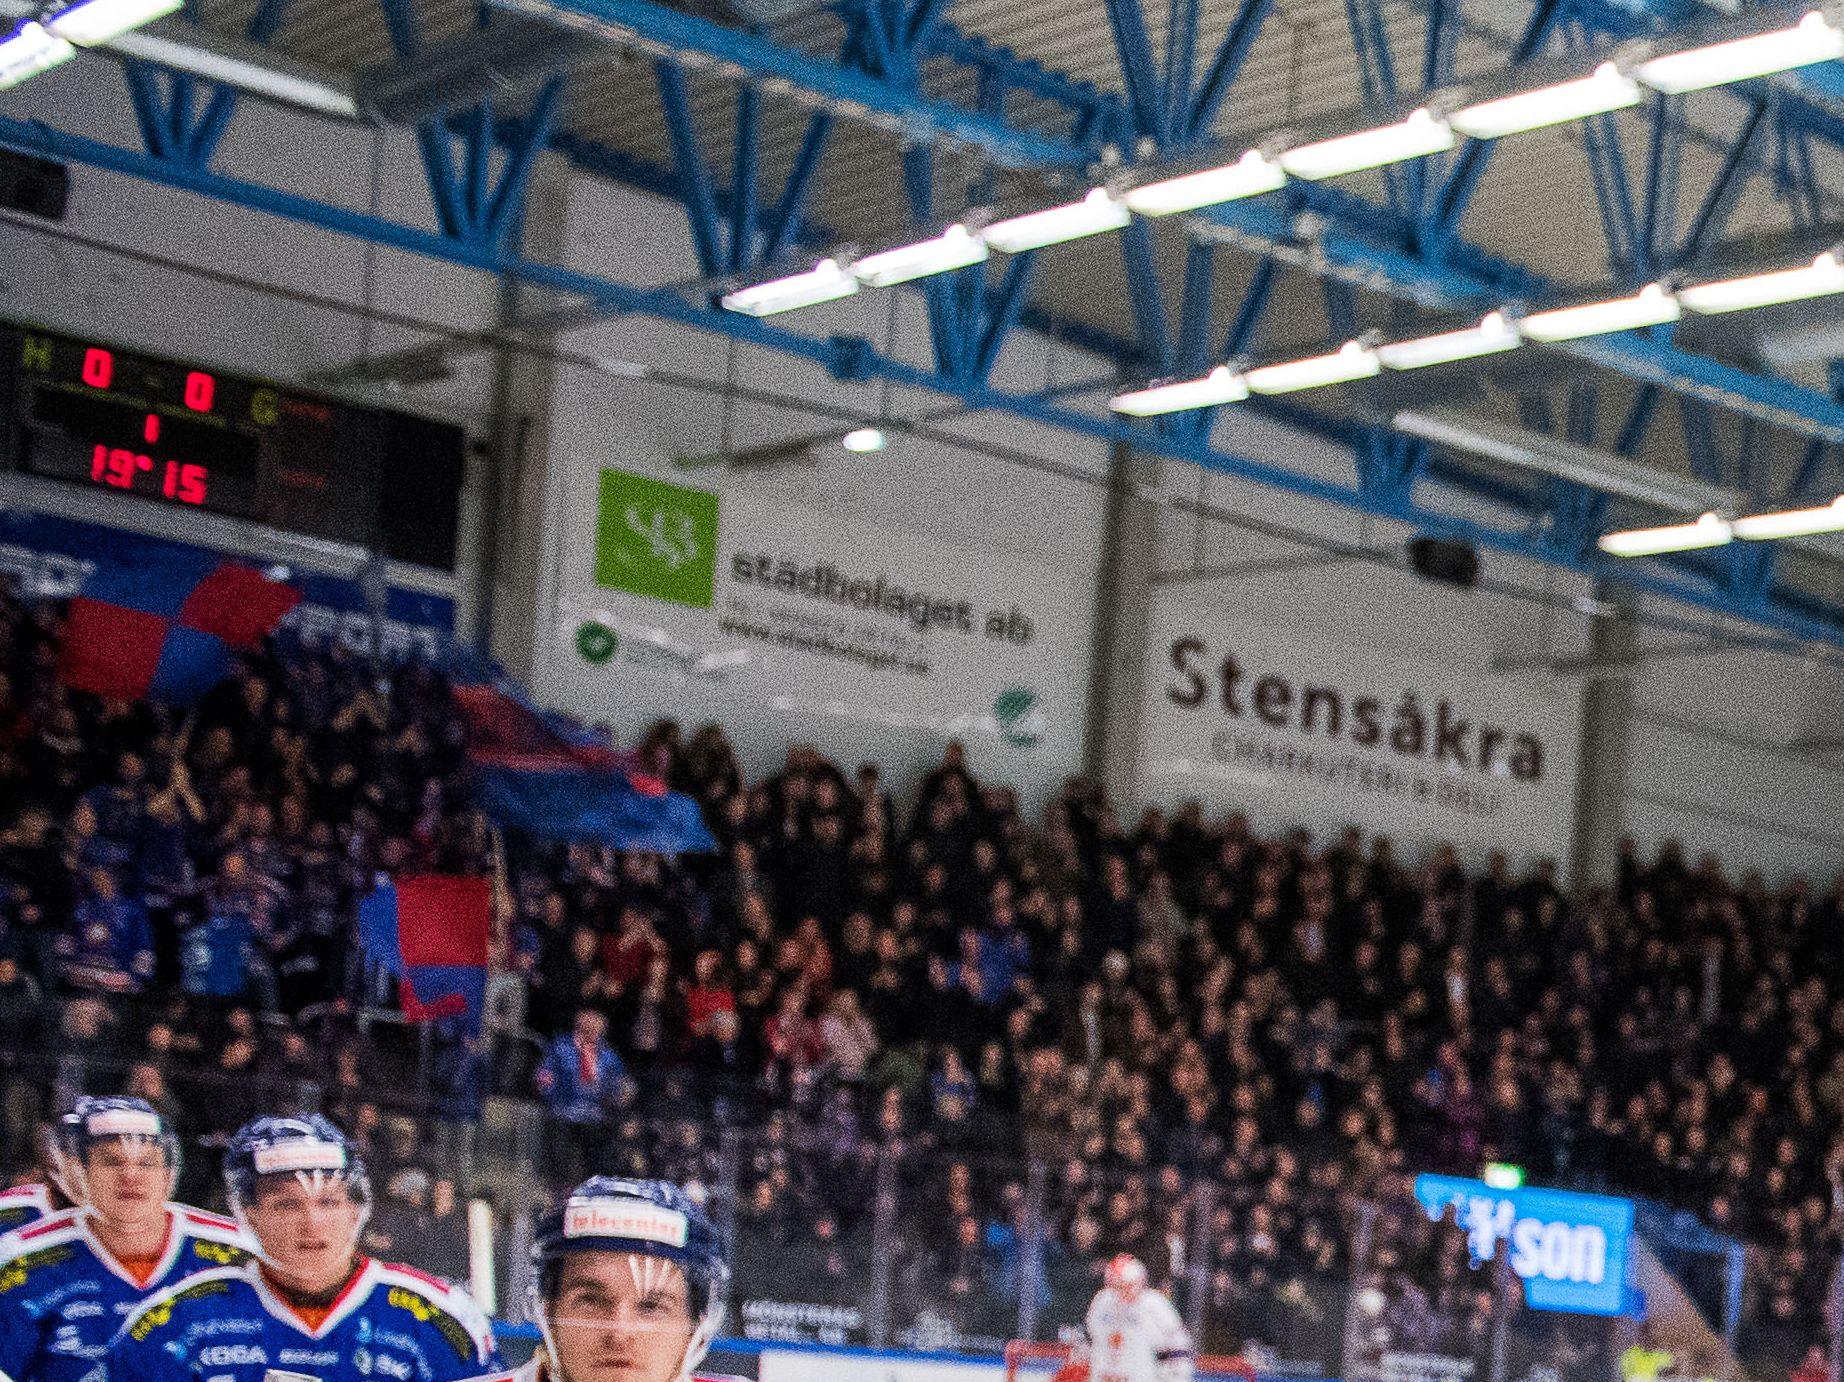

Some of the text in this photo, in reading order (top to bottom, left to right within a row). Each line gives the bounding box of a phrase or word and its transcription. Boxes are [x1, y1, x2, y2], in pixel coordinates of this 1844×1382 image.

[83, 348, 113, 388] 0
[184, 372, 215, 412] 0
[1166, 634, 1543, 783] Stensåkra
